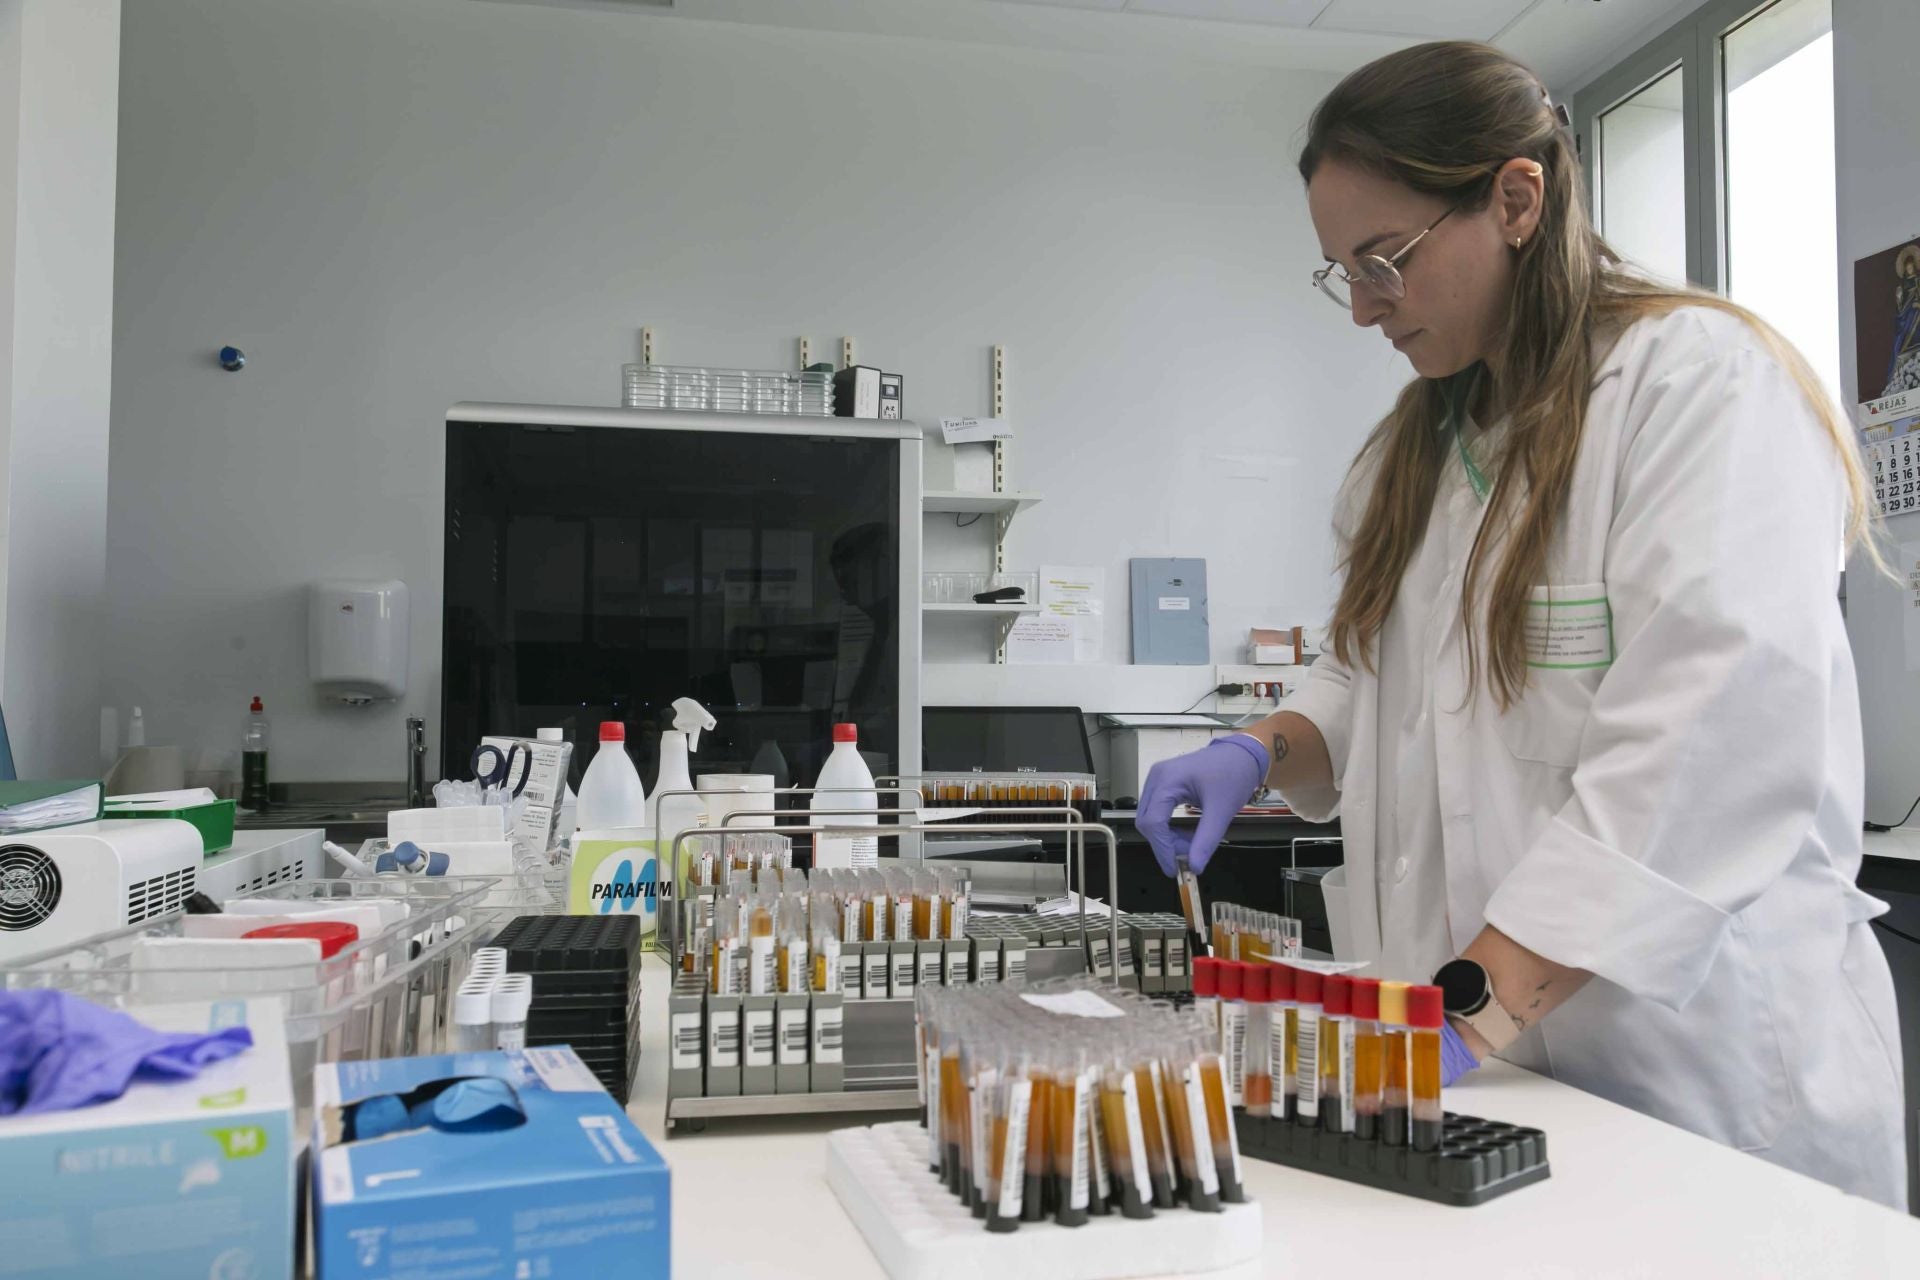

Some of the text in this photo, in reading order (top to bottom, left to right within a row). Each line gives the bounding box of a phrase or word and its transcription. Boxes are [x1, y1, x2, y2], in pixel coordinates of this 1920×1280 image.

[1891, 444, 1895, 454] 1
[1904, 441, 1910, 451] 2
[1877, 462, 1882, 471] 7
[1891, 458, 1896, 468] 8
[1904, 455, 1910, 465] 9
[1875, 475, 1885, 485] 14
[1889, 472, 1898, 482] 15
[1903, 468, 1913, 479] 16
[1876, 489, 1884, 499] 21
[1889, 486, 1900, 497] 22
[1903, 482, 1914, 494] 23
[1889, 499, 1900, 511] 29
[1903, 497, 1914, 508] 30
[591, 881, 672, 899] PARAFILM
